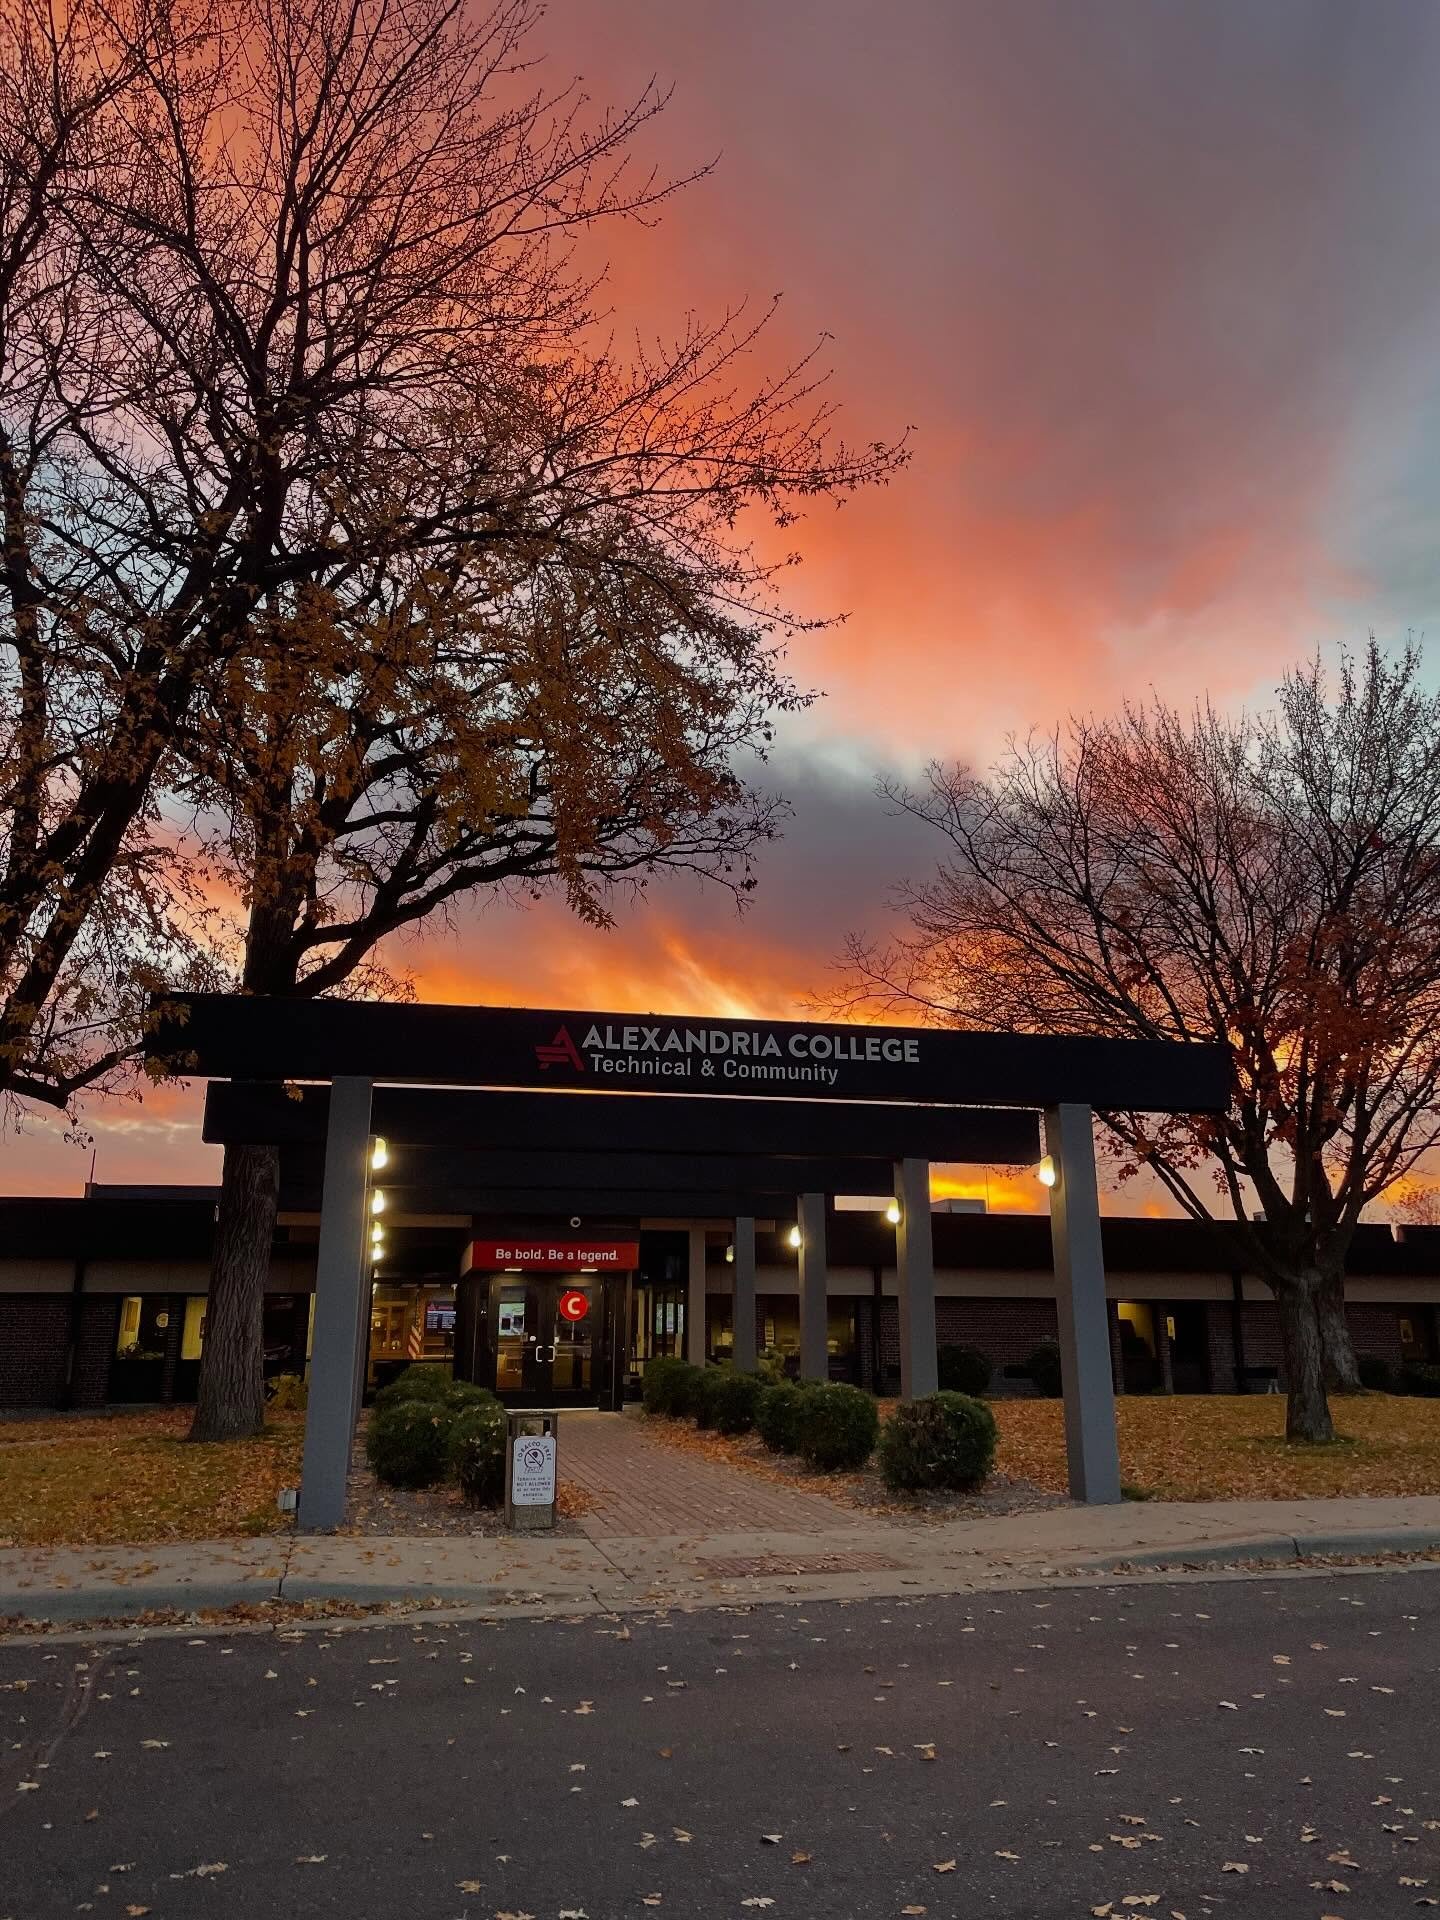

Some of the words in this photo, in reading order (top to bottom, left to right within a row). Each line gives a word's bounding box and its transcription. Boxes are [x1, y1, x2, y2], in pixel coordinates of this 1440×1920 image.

[581, 1023, 783, 1057] ALEXANDRIA
[787, 1034, 920, 1063] COLLEGE
[589, 1053, 691, 1076] Technical
[700, 1058, 716, 1077] &
[722, 1059, 839, 1086] Community
[495, 1248, 512, 1259] Be
[515, 1248, 545, 1260] bold.
[548, 1249, 564, 1260] Be
[567, 1251, 574, 1260] a
[577, 1249, 619, 1263] legend.
[567, 1296, 580, 1315] C
